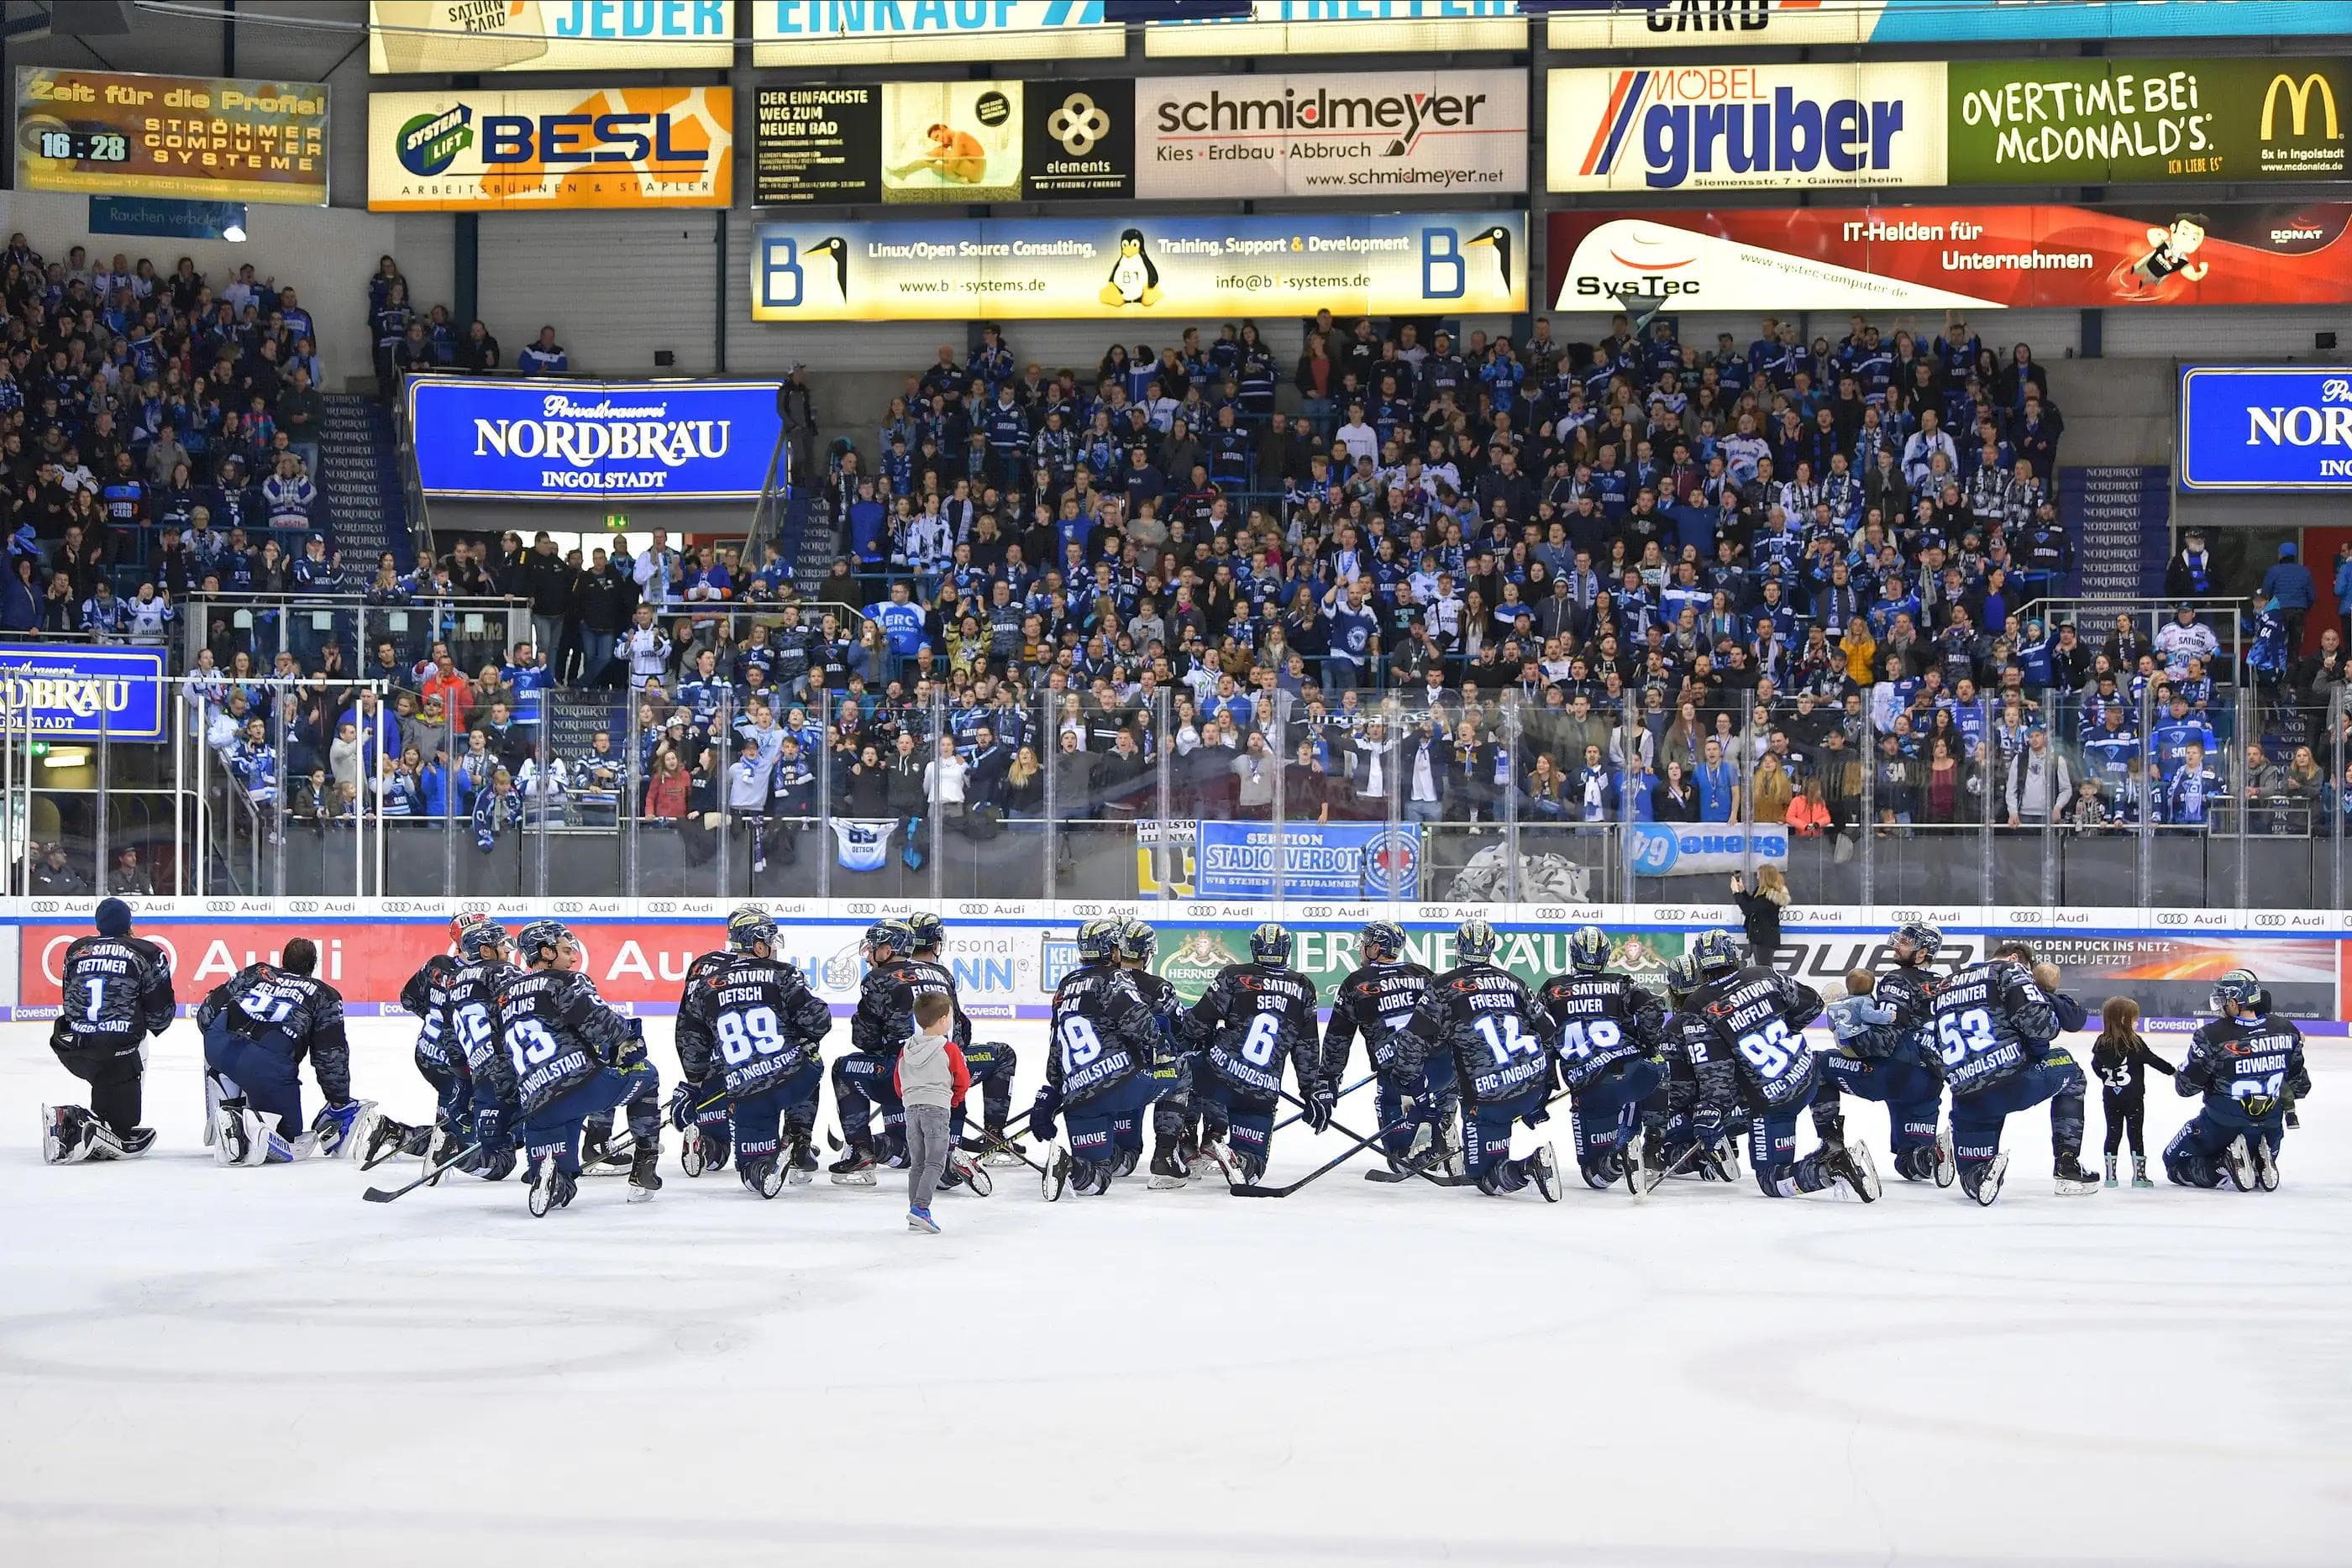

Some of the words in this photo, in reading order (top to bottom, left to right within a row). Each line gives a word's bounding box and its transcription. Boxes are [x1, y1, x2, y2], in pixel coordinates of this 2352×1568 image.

[467, 11, 505, 34] CARD
[557, 0, 723, 38] JEDER
[1650, 68, 1767, 100] MÖBEL
[31, 81, 96, 102] Zeit
[106, 86, 153, 106] für
[164, 89, 210, 109] die
[759, 92, 788, 106] DER
[790, 90, 869, 105] EINFACHSTE
[759, 107, 790, 120] WEG
[793, 106, 822, 120] ZUM
[1158, 88, 1486, 142] schmidmeyer
[144, 118, 323, 139] STRÖHMER
[407, 108, 463, 149] SYSTEM
[759, 123, 806, 136] NEUEN
[809, 121, 838, 135] BAD
[1644, 87, 1903, 188] gruber
[144, 134, 322, 155] COMPUTER
[432, 132, 463, 160] LIFT
[481, 113, 709, 164] BESL
[154, 150, 312, 170] SYSTEME
[1157, 146, 1194, 161] Kies
[1209, 144, 1274, 160] Erdbau
[1290, 142, 1371, 160] Abbruch
[2277, 149, 2287, 159] in
[2290, 148, 2345, 160] Ingolstadt
[1047, 160, 1110, 173] elements
[2168, 159, 2181, 174] ICH
[2186, 158, 2207, 173] LIEBE
[2260, 162, 2343, 171] www.mcdonalds.de
[1306, 167, 1504, 188] www.schmidmeyer.net
[1694, 178, 1777, 186] Siemensstr.
[402, 181, 577, 195] ARBEITSBÜHNEN
[595, 183, 602, 193] &
[620, 181, 710, 192] STAPLER
[111, 207, 164, 223] Rauchen
[1843, 222, 1944, 242] IT-Helden
[1950, 221, 1983, 241] für
[2271, 228, 2323, 240] DONAT
[868, 241, 956, 260] Linux/Open
[959, 239, 1010, 258] Source
[1013, 239, 1097, 259] Consulting,
[1158, 238, 1224, 257] Training,
[1226, 238, 1287, 256] Support
[1291, 237, 1304, 251] &
[1308, 236, 1410, 255] Development
[1942, 250, 2093, 271] Unternehmen
[1577, 275, 1700, 298] SysTec
[543, 394, 667, 419] Privatbrauerei
[474, 419, 731, 467] NORDBRÄU
[542, 471, 667, 489] INGOLSTADT
[885, 614, 915, 626] ERC
[2178, 637, 2206, 648] SATURN
[1228, 878, 1269, 886] STEHEN
[1299, 879, 1359, 889] ZUSAMMEN
[64, 902, 94, 912] Audi
[241, 902, 271, 912] Audi
[324, 902, 355, 912] Audi
[496, 902, 528, 912] Audi
[589, 902, 620, 912] Audi
[774, 903, 805, 913] Audi
[882, 904, 911, 914] Audi
[1222, 906, 1253, 916] Audi
[1455, 907, 1487, 918] Audi
[1572, 909, 1603, 919] Audi
[1810, 910, 1841, 921] Audi
[1929, 911, 1961, 922] Audi
[2194, 914, 2228, 925] Audi
[2292, 915, 2325, 926] Audi
[92, 944, 134, 960] SATURN
[2045, 941, 2071, 952] DEN
[2074, 941, 2111, 952] PUCK
[2113, 941, 2134, 952] INS
[2138, 942, 2170, 954] NETZ
[76, 959, 126, 975] STETTMER
[2055, 954, 2087, 965] DICH
[2090, 954, 2132, 966] JETZT!
[727, 969, 774, 985] SATURN
[1380, 977, 1425, 994] SATURN
[1475, 977, 1520, 992] SATURN
[1950, 967, 1989, 987] SATURN
[276, 977, 318, 996] SATURN
[508, 978, 548, 999] SATURN
[1263, 978, 1303, 999] SATURN
[1572, 981, 1620, 996] SATURN
[1729, 979, 1775, 1008] SATURN
[85, 978, 104, 1022] 1
[718, 987, 762, 1005] DETSCH
[1378, 992, 1414, 1012] JOBKE
[1469, 994, 1515, 1010] FRIESEN
[15, 1007, 59, 1018] covestro
[501, 997, 535, 1022] COLLINS
[964, 1005, 1010, 1017] covestro
[1567, 999, 1603, 1014] OLVER
[1726, 999, 1774, 1032] HÖFFLIN
[2150, 1020, 2197, 1031] covestro
[717, 1006, 785, 1066] 89
[1058, 1015, 1102, 1075] 19
[1242, 1012, 1278, 1067] 6
[1474, 1015, 1538, 1064] 14
[1940, 1008, 1997, 1065] 53
[2250, 1034, 2292, 1051] SATURN
[504, 1017, 557, 1076] 13
[1377, 1044, 1394, 1065] ERC
[1739, 1019, 1803, 1078] 92
[1068, 1051, 1130, 1092] INGOLSTADT
[1210, 1048, 1226, 1068] ERC
[1228, 1061, 1281, 1093] INGOLSTADT
[1956, 1042, 2022, 1086] INGOLSTADT
[2235, 1054, 2286, 1074] EDWARDS
[524, 1051, 587, 1097] INGOLSTADT
[2102, 1064, 2132, 1087] 23
[1475, 1074, 1498, 1093] ERC
[1762, 1078, 1787, 1099] ERC
[1232, 1125, 1265, 1143] CINQUE
[1572, 1112, 1585, 1156] SATURN
[1904, 1123, 1935, 1135] CINQUE
[741, 1139, 777, 1153] CINQUE
[1072, 1131, 1107, 1146] CINQUE
[1752, 1117, 1767, 1162] SATURN
[531, 1142, 566, 1158] CINQUE
[1958, 1146, 1993, 1158] CINQUE
